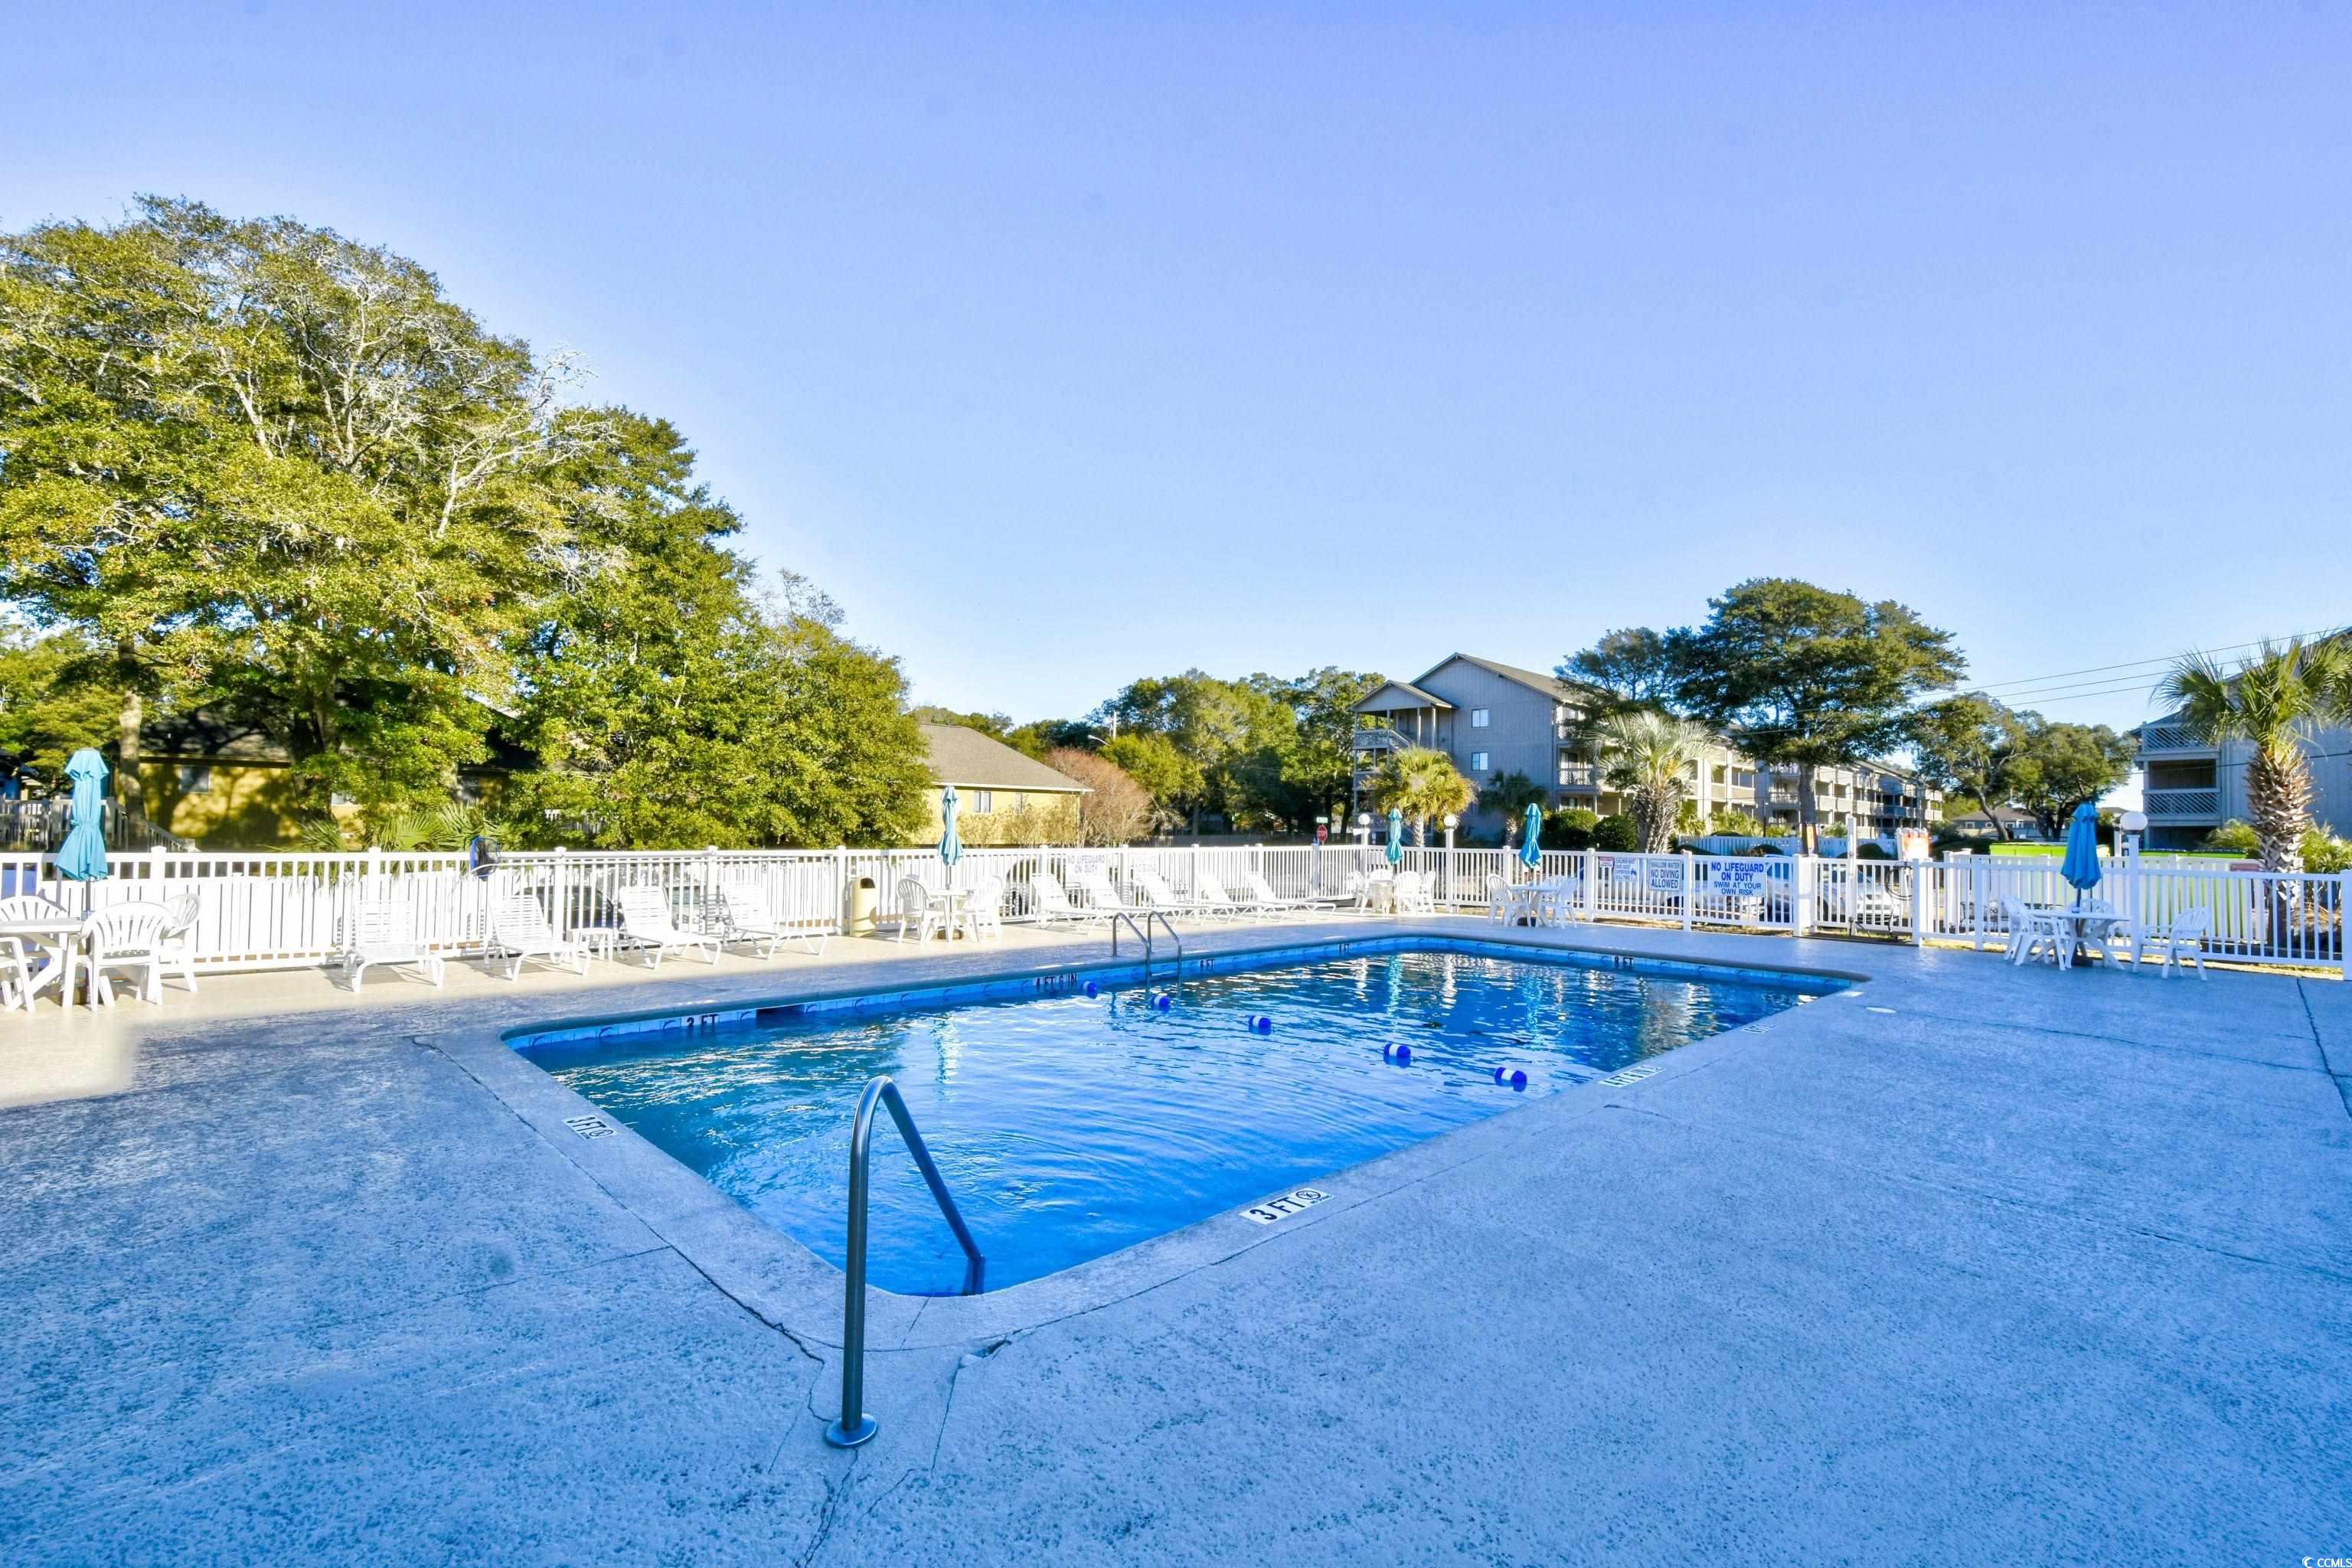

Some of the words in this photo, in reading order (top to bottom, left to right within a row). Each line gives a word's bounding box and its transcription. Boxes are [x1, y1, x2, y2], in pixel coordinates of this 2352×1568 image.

[1067, 855, 1075, 864] NO
[1085, 864, 1097, 873] DUTY
[1711, 861, 1721, 871] NO
[1724, 862, 1764, 872] LIFEGUARD
[1661, 870, 1679, 879] DIVING
[1721, 871, 1731, 880] ON
[1735, 872, 1753, 881] DUTY
[1651, 879, 1678, 888] ALLOWED
[701, 1014, 718, 1024] FT
[1249, 1209, 1278, 1220] 3
[1266, 1197, 1305, 1214] FT
